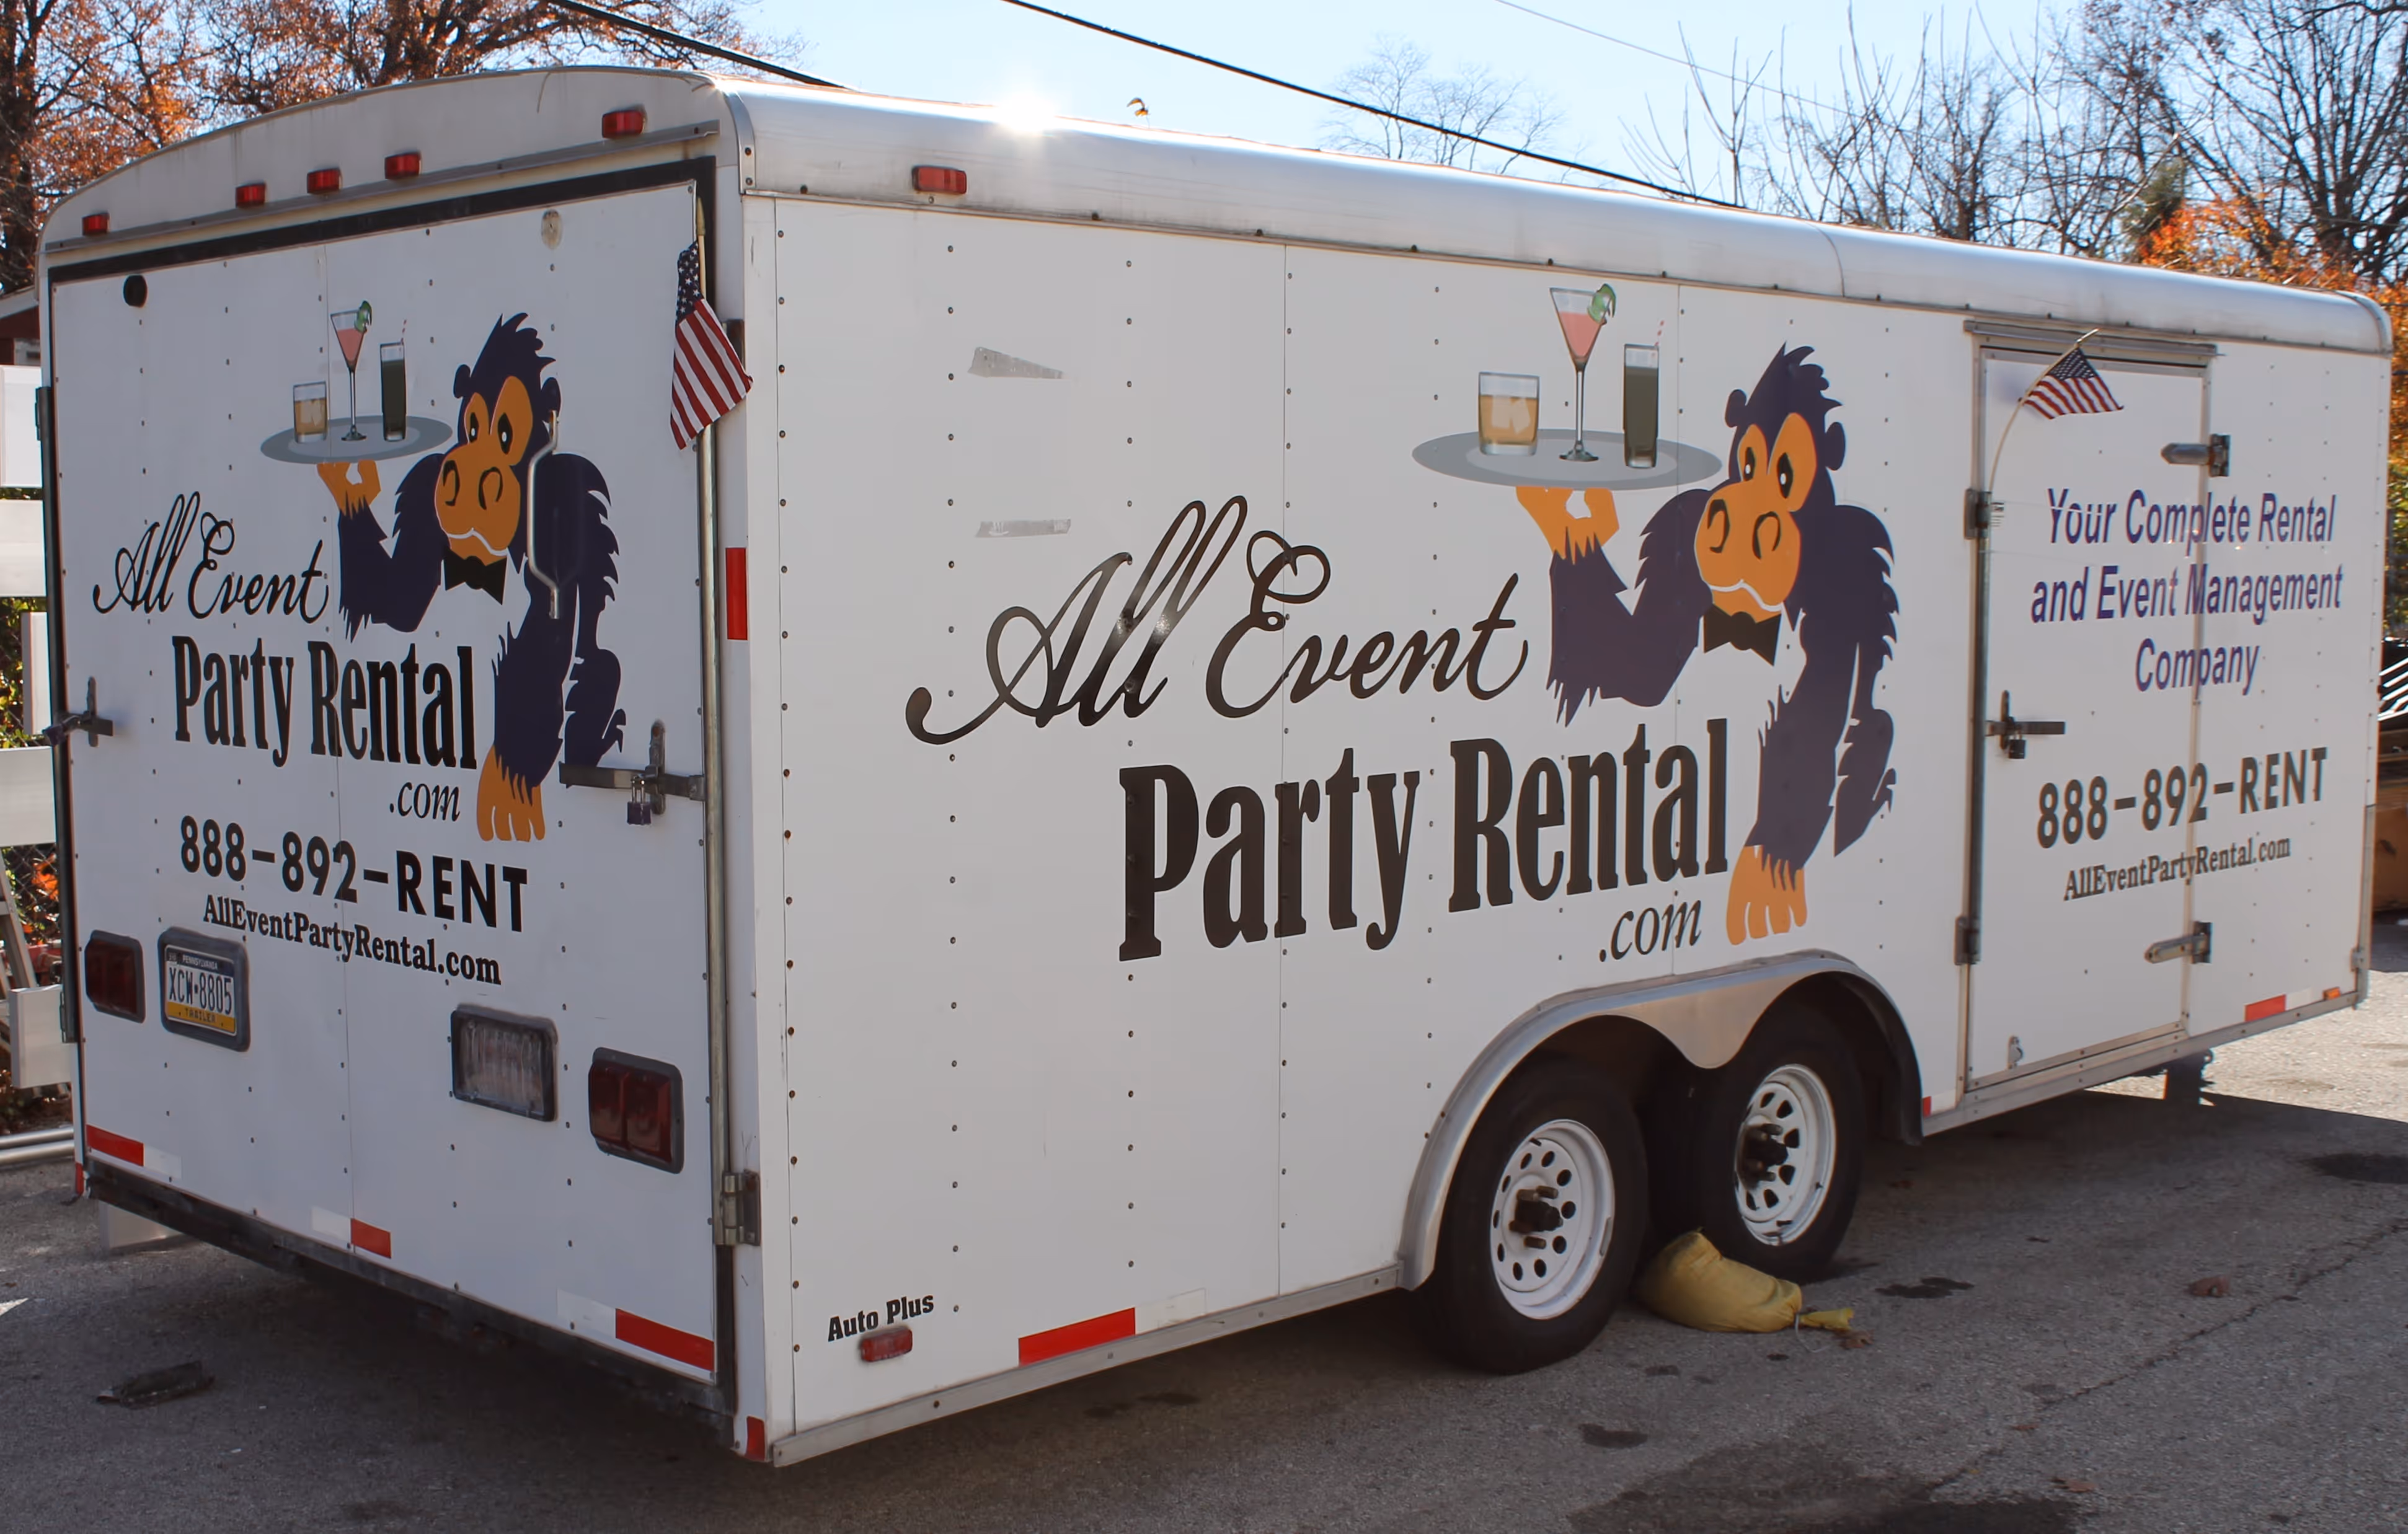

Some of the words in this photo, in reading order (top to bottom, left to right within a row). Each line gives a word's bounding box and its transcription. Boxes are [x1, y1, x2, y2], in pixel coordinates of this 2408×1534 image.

[2047, 487, 2117, 545] Your
[2126, 488, 2250, 557] Complete
[2258, 493, 2336, 543] Rental
[92, 491, 200, 614] All
[187, 511, 329, 624] Event
[905, 495, 1248, 746] All
[1205, 530, 1528, 719] Event
[2030, 565, 2089, 624] and
[2096, 565, 2178, 620] Event
[2184, 565, 2344, 626] Management
[172, 635, 294, 767] Party
[308, 641, 477, 770] Rental
[2135, 638, 2260, 700] Company
[389, 782, 461, 822] .com
[2037, 747, 2327, 849] 888-892-RENT
[1119, 747, 1420, 962] Party
[1448, 718, 1729, 913] Rental
[2063, 837, 2291, 902] AllEventPartyRental.com
[180, 815, 528, 933] 888-892-RENT
[182, 954, 218, 971] PENNSYLVANIA
[203, 894, 502, 986] AllEventPartyRental.com
[1598, 900, 1702, 963] .com
[185, 1007, 217, 1023] TRAILER
[827, 1310, 879, 1342] Auto
[886, 1295, 935, 1325] Plus
